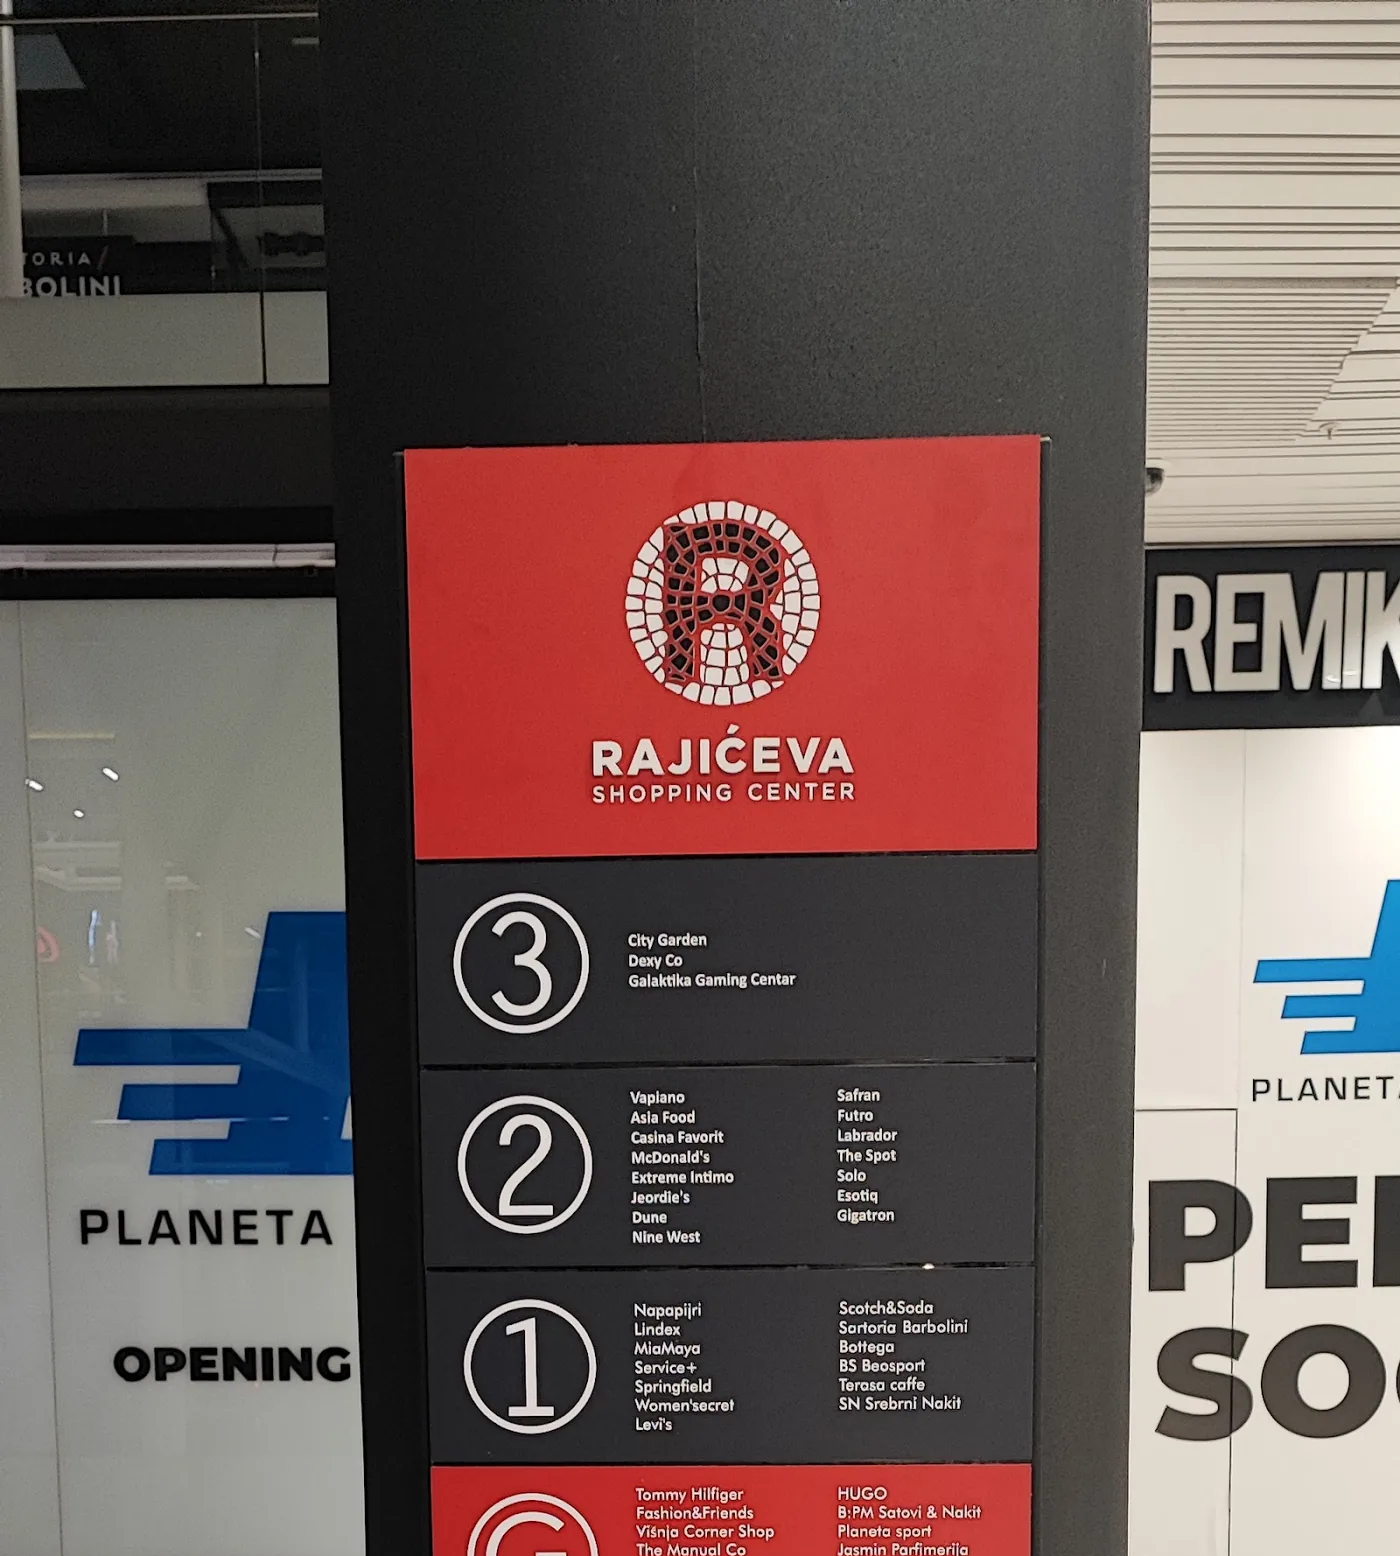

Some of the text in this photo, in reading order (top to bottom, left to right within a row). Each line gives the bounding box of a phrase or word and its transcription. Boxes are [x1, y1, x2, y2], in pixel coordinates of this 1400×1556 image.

[592, 723, 855, 777] RAJIĆEVA
[592, 782, 855, 803] SHOPPING CENTER
[627, 932, 708, 950] City Garden
[491, 911, 552, 1017] 3
[628, 953, 683, 970] Dexy Co
[628, 972, 797, 989] Galaktika Gaming Centar
[837, 1087, 881, 1102] Safran
[1252, 1075, 1400, 1102] PLANET
[629, 1090, 686, 1107] Vapiano
[630, 1109, 696, 1125] Asia Food
[837, 1108, 874, 1123] Futro
[630, 1129, 724, 1145] Casina Favorit
[837, 1127, 898, 1142] Labrador
[498, 1113, 554, 1216] 2
[631, 1149, 710, 1165] McDonald's
[836, 1148, 897, 1165] The Spot
[631, 1169, 735, 1185] Extreme Intimo
[837, 1168, 867, 1182] Solo
[630, 1189, 691, 1205] Jeordie's
[837, 1188, 878, 1205] Esotiq
[632, 1210, 668, 1224] Dune
[837, 1207, 895, 1225] Gigatron
[79, 1209, 333, 1245] PLANETA
[1148, 1176, 1400, 1292] PE
[632, 1230, 701, 1244] Nine West
[634, 1301, 702, 1321] Napapijri
[839, 1299, 934, 1316] Scotch&Soda
[634, 1321, 681, 1337] Lindex
[838, 1318, 968, 1335] Sartoria Barbolini
[634, 1340, 701, 1359] MiaMaya
[839, 1339, 895, 1357] Bottega
[113, 1346, 351, 1382] OPENING
[505, 1317, 555, 1417] 1
[634, 1359, 698, 1375] Service+
[839, 1358, 926, 1376] BS Beosport
[634, 1378, 712, 1397] Springfield
[838, 1375, 926, 1392] Terasa caffe
[1155, 1324, 1400, 1442] SO
[634, 1398, 735, 1412] Women'secret
[838, 1394, 962, 1411] SN Srebrni Nakit
[635, 1416, 673, 1431] Levi's
[635, 1486, 744, 1505] Tommy Hilfiger
[838, 1486, 888, 1501] HUGO
[636, 1505, 754, 1520] Fashion&Friends
[838, 1504, 982, 1519] B:PM Satovi & Nakit
[683, 1524, 735, 1538] Corner
[738, 1523, 775, 1542] Shop
[838, 1523, 932, 1541] Planeta sport
[635, 1542, 747, 1556] The Manual Co
[837, 1542, 887, 1556] Jasmin
